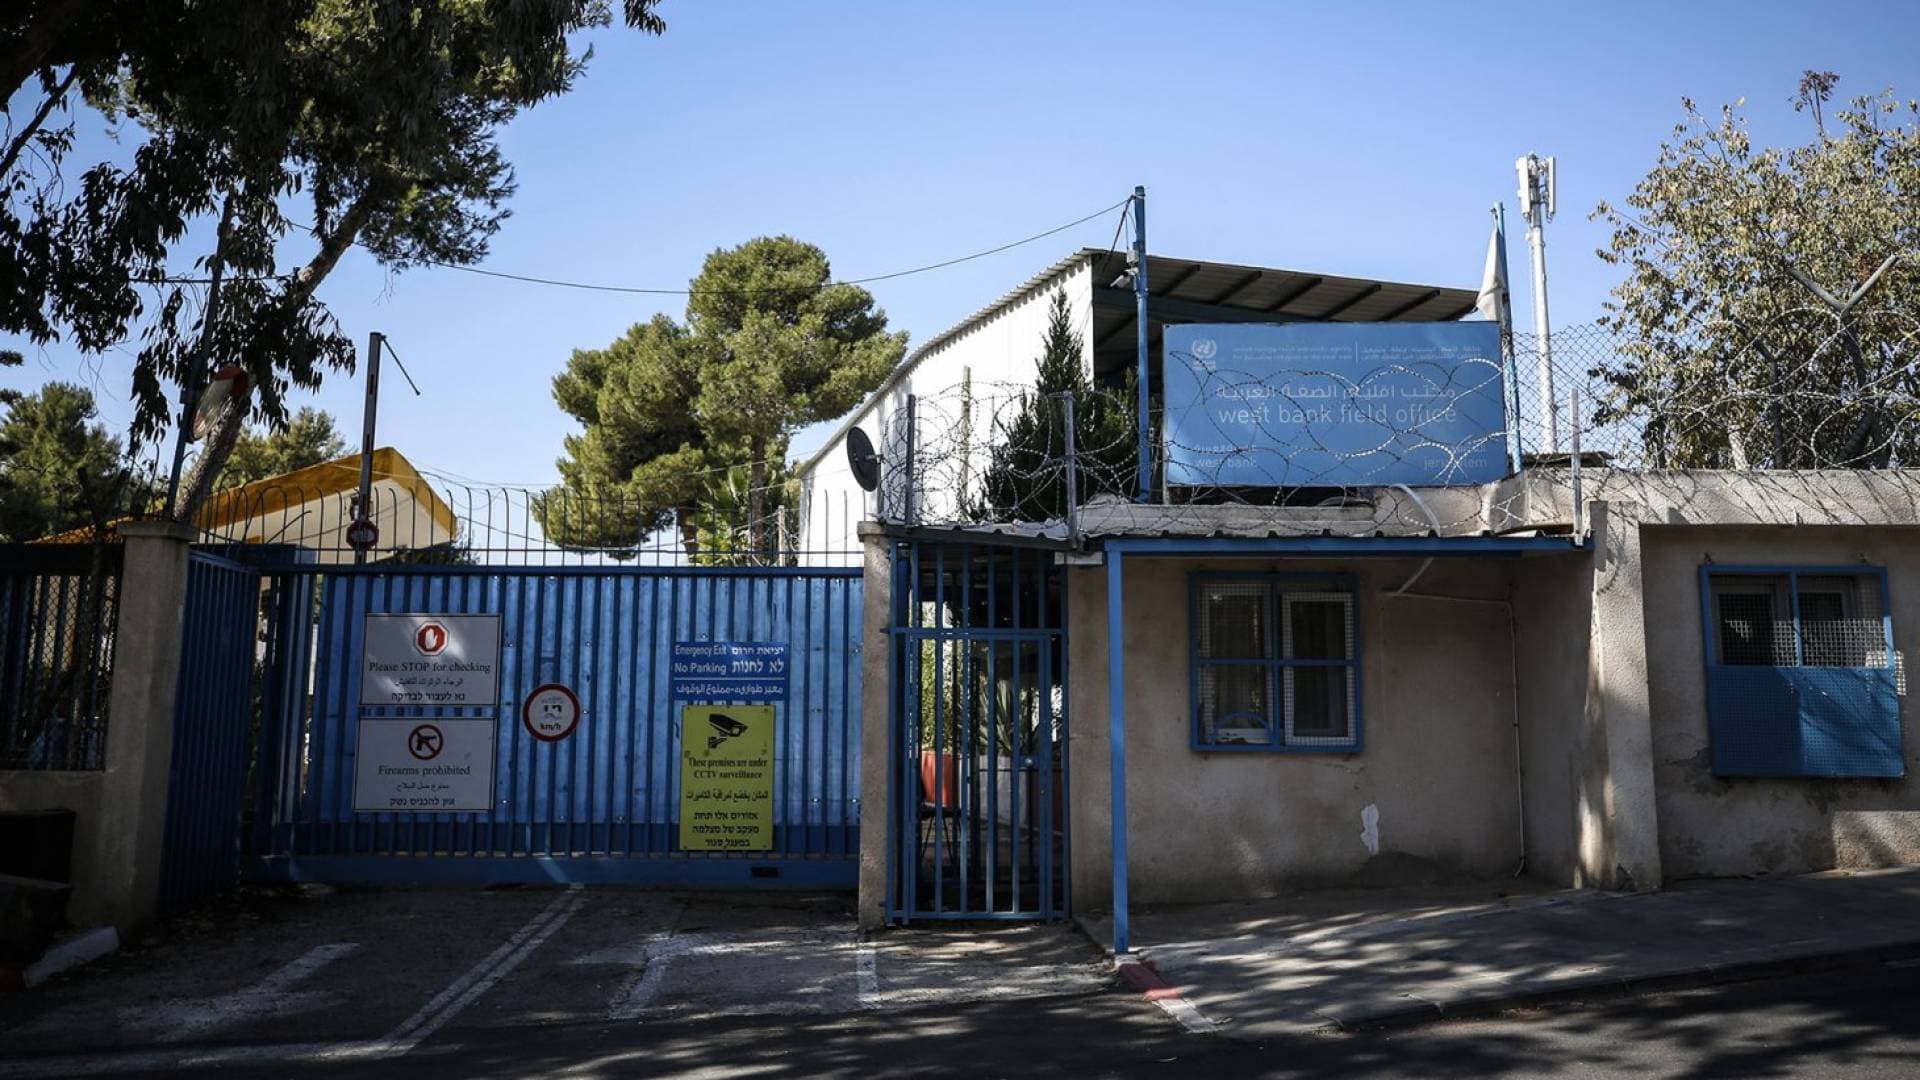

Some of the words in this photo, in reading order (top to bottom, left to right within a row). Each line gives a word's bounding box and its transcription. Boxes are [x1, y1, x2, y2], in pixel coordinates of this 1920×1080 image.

[1218, 406, 1270, 423] west
[1279, 404, 1332, 423] bank
[1341, 403, 1387, 423] field
[1396, 403, 1457, 423] office
[675, 645, 712, 657] Emergency
[713, 645, 727, 655] Exit
[731, 646, 754, 655] חרום
[756, 646, 784, 655] יציאת
[369, 662, 399, 672] Please
[401, 662, 430, 672] STOP
[433, 662, 447, 672] for
[449, 662, 491, 674] checking
[674, 663, 688, 673] No
[690, 663, 727, 675] Parking
[732, 658, 764, 673] לחנות
[769, 658, 784, 673] לא
[391, 691, 423, 702] לבדיקה
[426, 691, 452, 701] לעצור
[455, 693, 465, 701] נא
[540, 722, 561, 730] km/h
[689, 757, 707, 767] These
[708, 757, 736, 768] premises
[748, 758, 768, 767] under
[378, 765, 419, 775] Firearms
[422, 765, 471, 777] prohibited
[694, 770, 719, 778] CCTV
[720, 770, 763, 778] surveillance
[389, 798, 407, 808] נשק
[410, 796, 440, 806] להכניס
[722, 825, 735, 834] של
